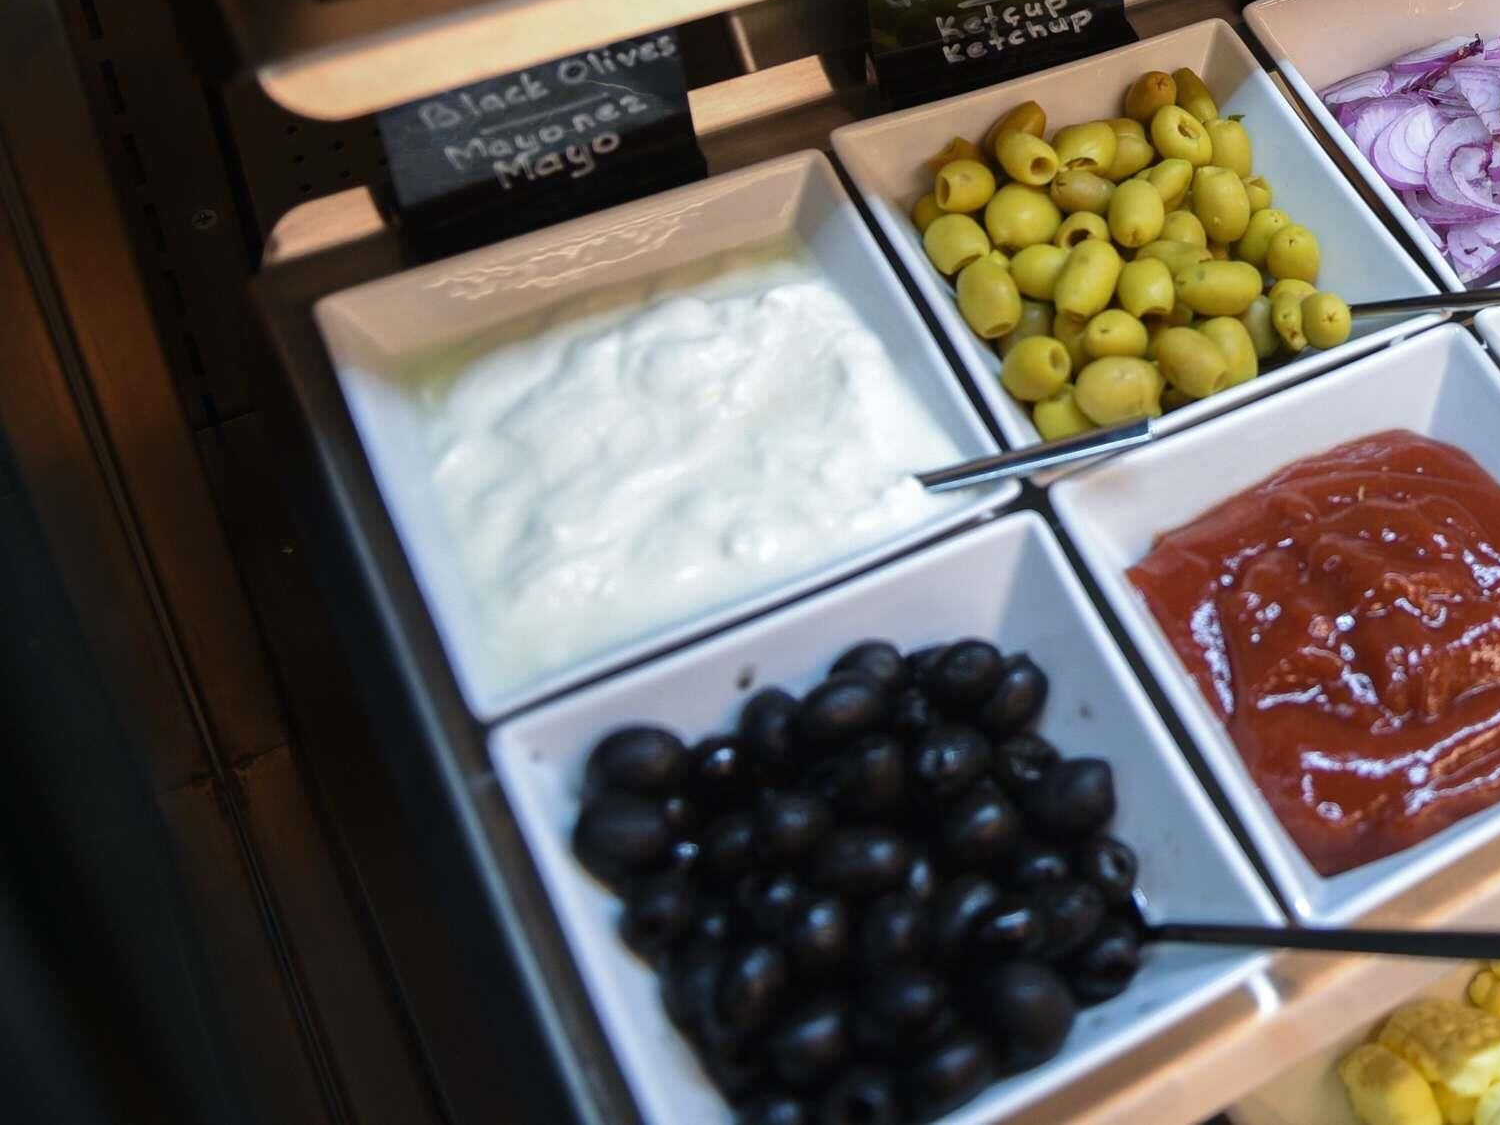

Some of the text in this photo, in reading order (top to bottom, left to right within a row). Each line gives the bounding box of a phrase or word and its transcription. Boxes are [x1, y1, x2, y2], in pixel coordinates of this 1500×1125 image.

[418, 35, 677, 130] Black Olives
[493, 131, 621, 190] Mayo
